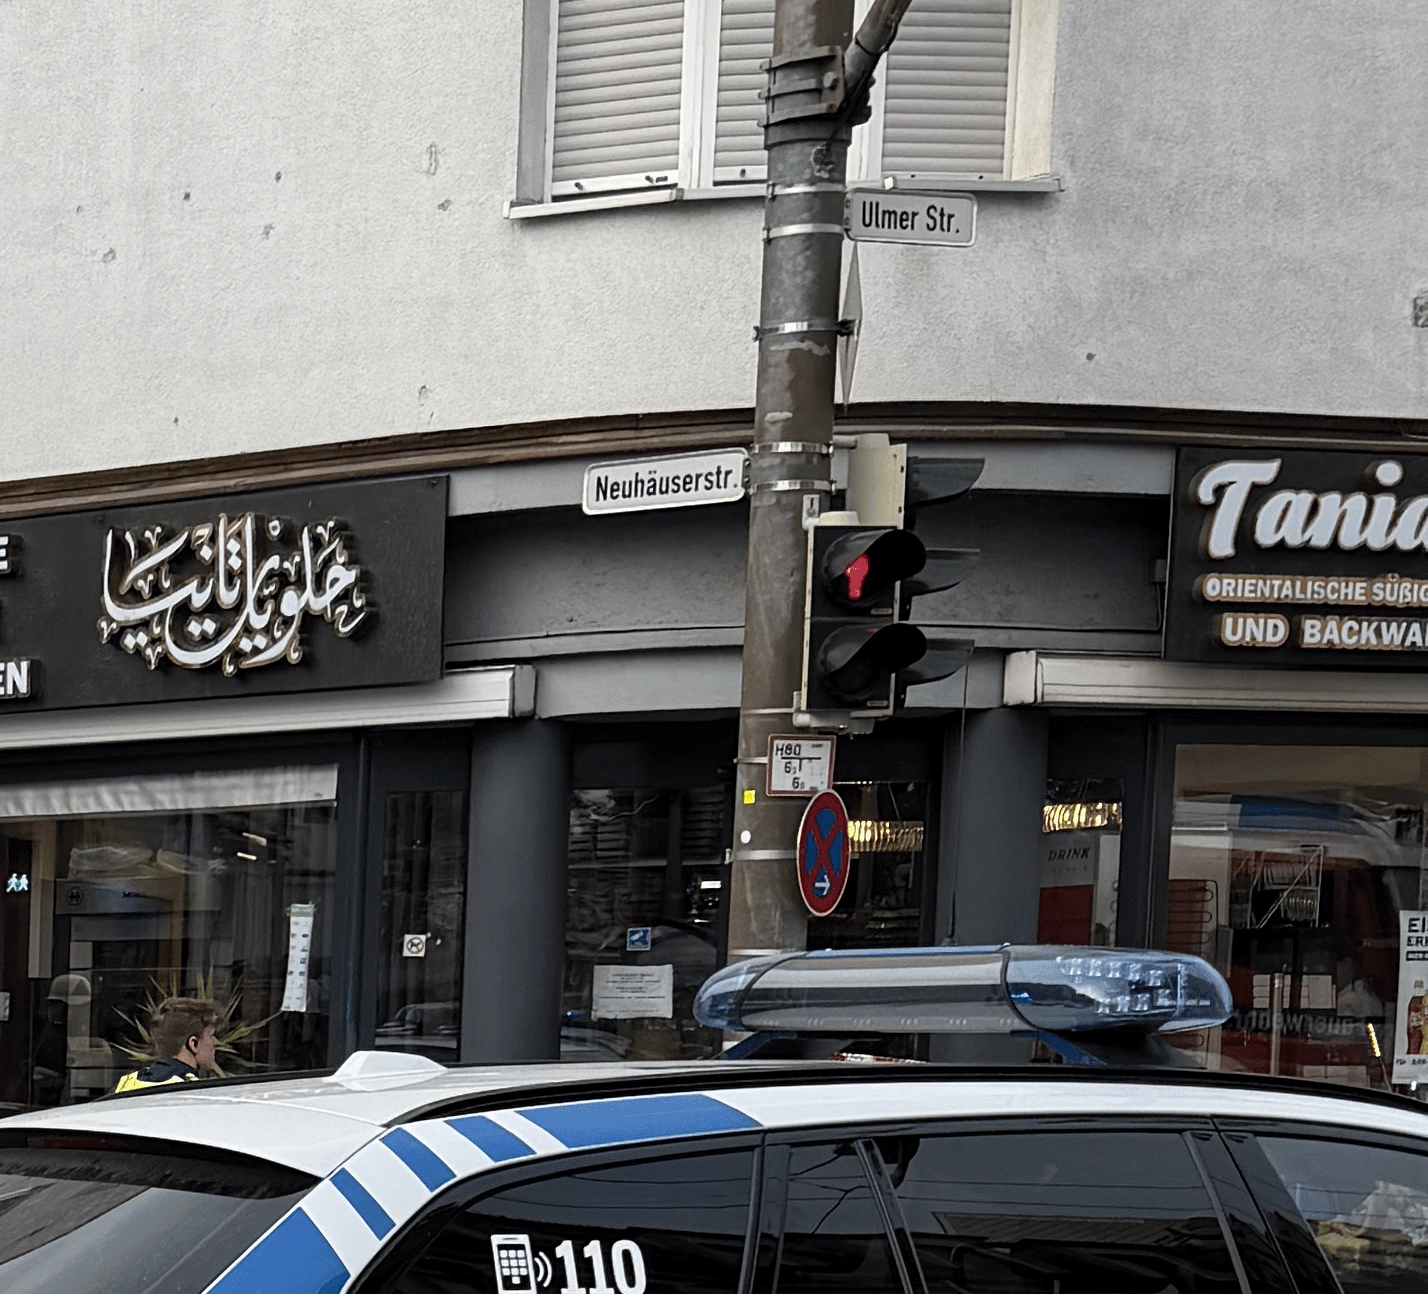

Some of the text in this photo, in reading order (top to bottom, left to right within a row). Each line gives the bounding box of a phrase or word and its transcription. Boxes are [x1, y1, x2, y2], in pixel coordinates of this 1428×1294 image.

[861, 200, 960, 234] Ulmer Str.
[595, 464, 739, 503] Neuhäuserstr.
[1205, 576, 1367, 603] ORIENTALISCHE
[1225, 616, 1428, 647] UND BACKWA
[1048, 847, 1091, 862] DRINK
